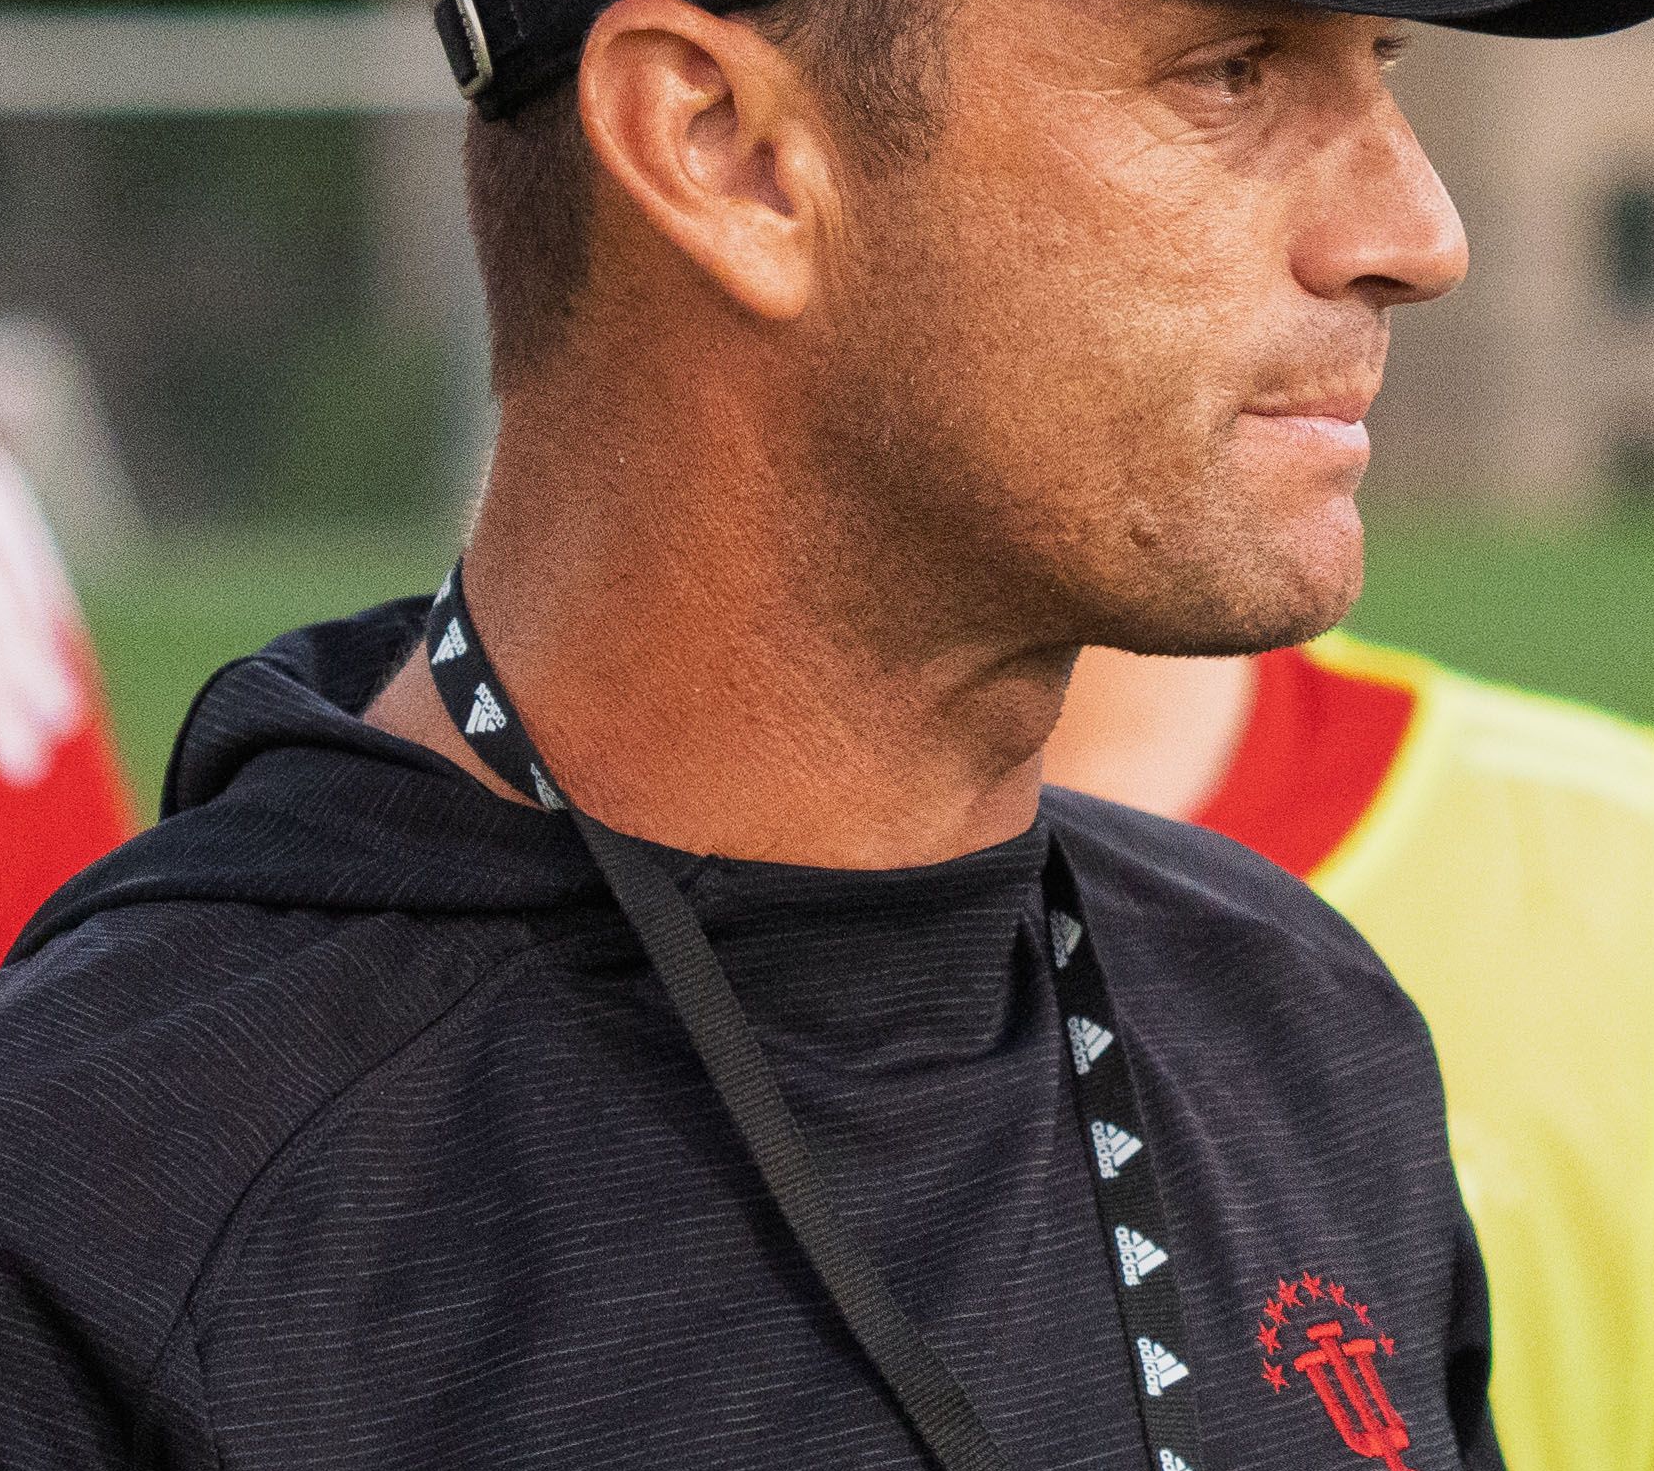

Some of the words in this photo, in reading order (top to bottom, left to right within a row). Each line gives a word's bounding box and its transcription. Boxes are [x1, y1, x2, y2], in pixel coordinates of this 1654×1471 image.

[474, 681, 508, 730] adidas
[1067, 1015, 1090, 1075] adidas
[1091, 1120, 1119, 1179] adidas
[1115, 1225, 1141, 1287] adidas
[1137, 1336, 1163, 1397] adidas
